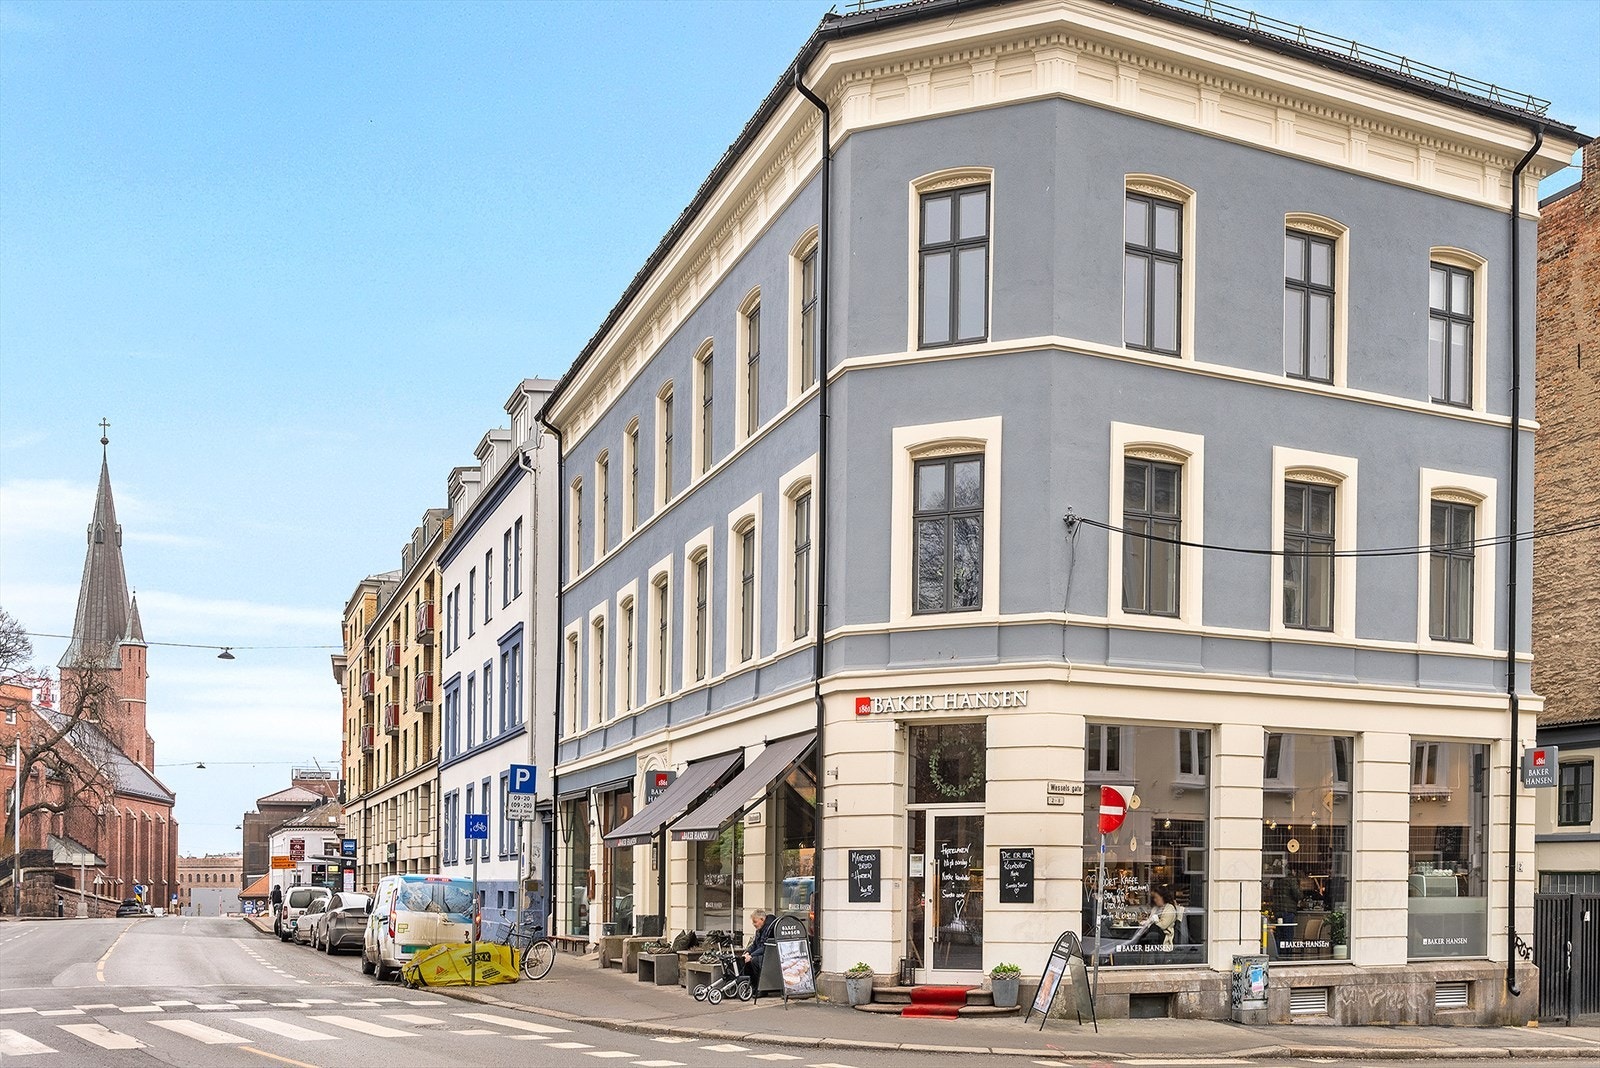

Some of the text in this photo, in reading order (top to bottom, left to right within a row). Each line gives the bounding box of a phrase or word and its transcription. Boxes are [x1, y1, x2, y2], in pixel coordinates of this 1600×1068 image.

[873, 694, 936, 714] BAKER
[943, 689, 1029, 710] HANSEN
[1528, 768, 1550, 776] BAKER
[515, 768, 530, 790] P
[1525, 776, 1553, 785] HANSEN
[1050, 784, 1082, 793] Wessels gate
[1120, 874, 1139, 885] KAFFE
[1305, 940, 1330, 948] HANSEN
[1445, 937, 1468, 945] HANSEN
[1122, 944, 1172, 952] BAKER HANSEN
